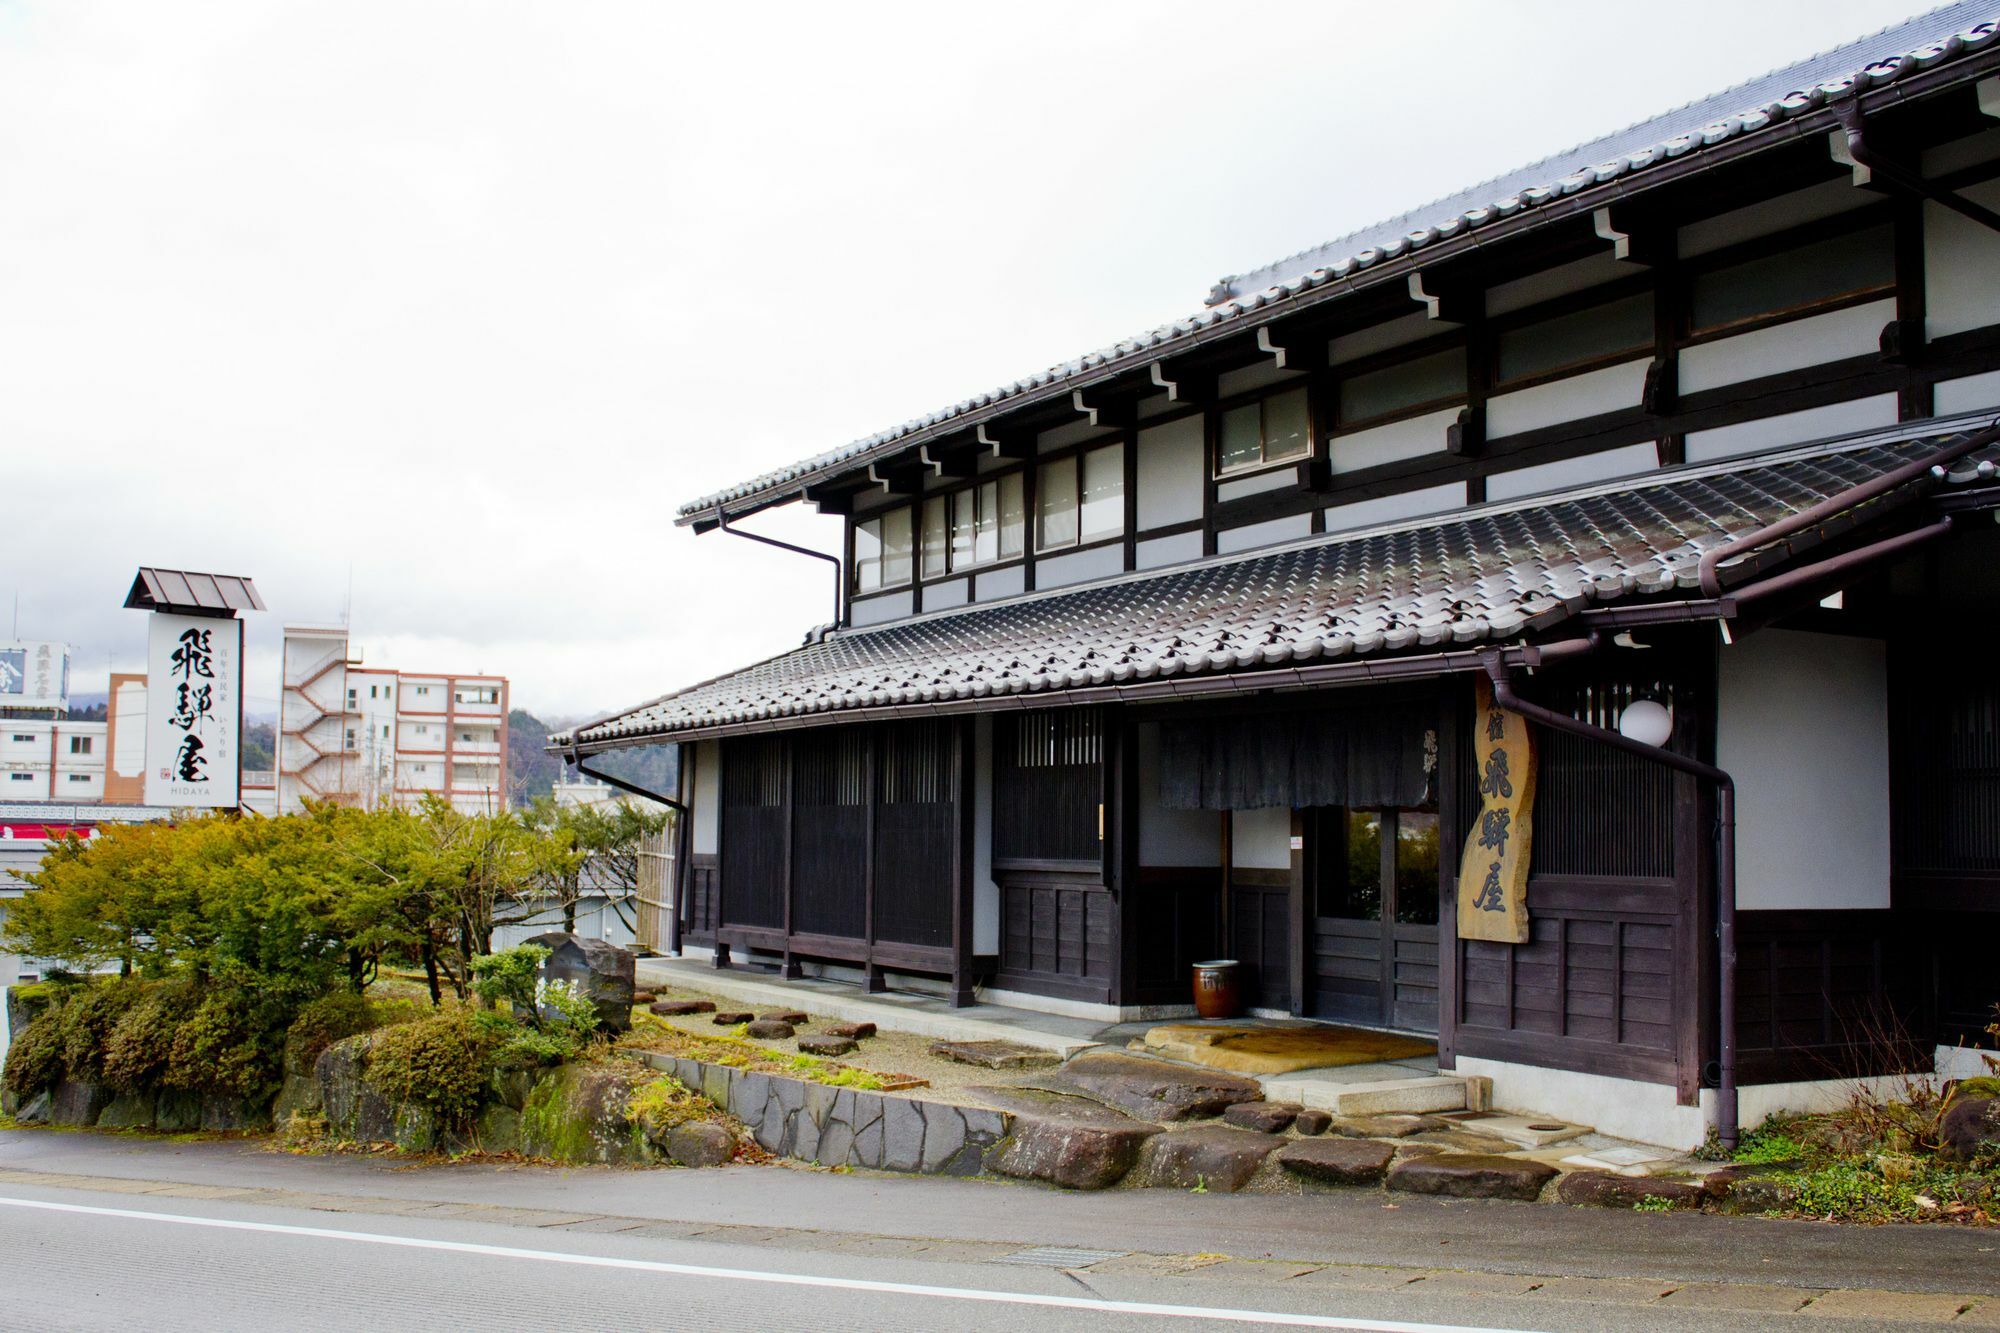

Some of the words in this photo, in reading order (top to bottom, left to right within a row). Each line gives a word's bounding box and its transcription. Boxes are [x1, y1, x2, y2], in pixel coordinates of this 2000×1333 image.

[168, 628, 215, 782] 飛騨屋
[170, 787, 211, 796] HIDAYA
